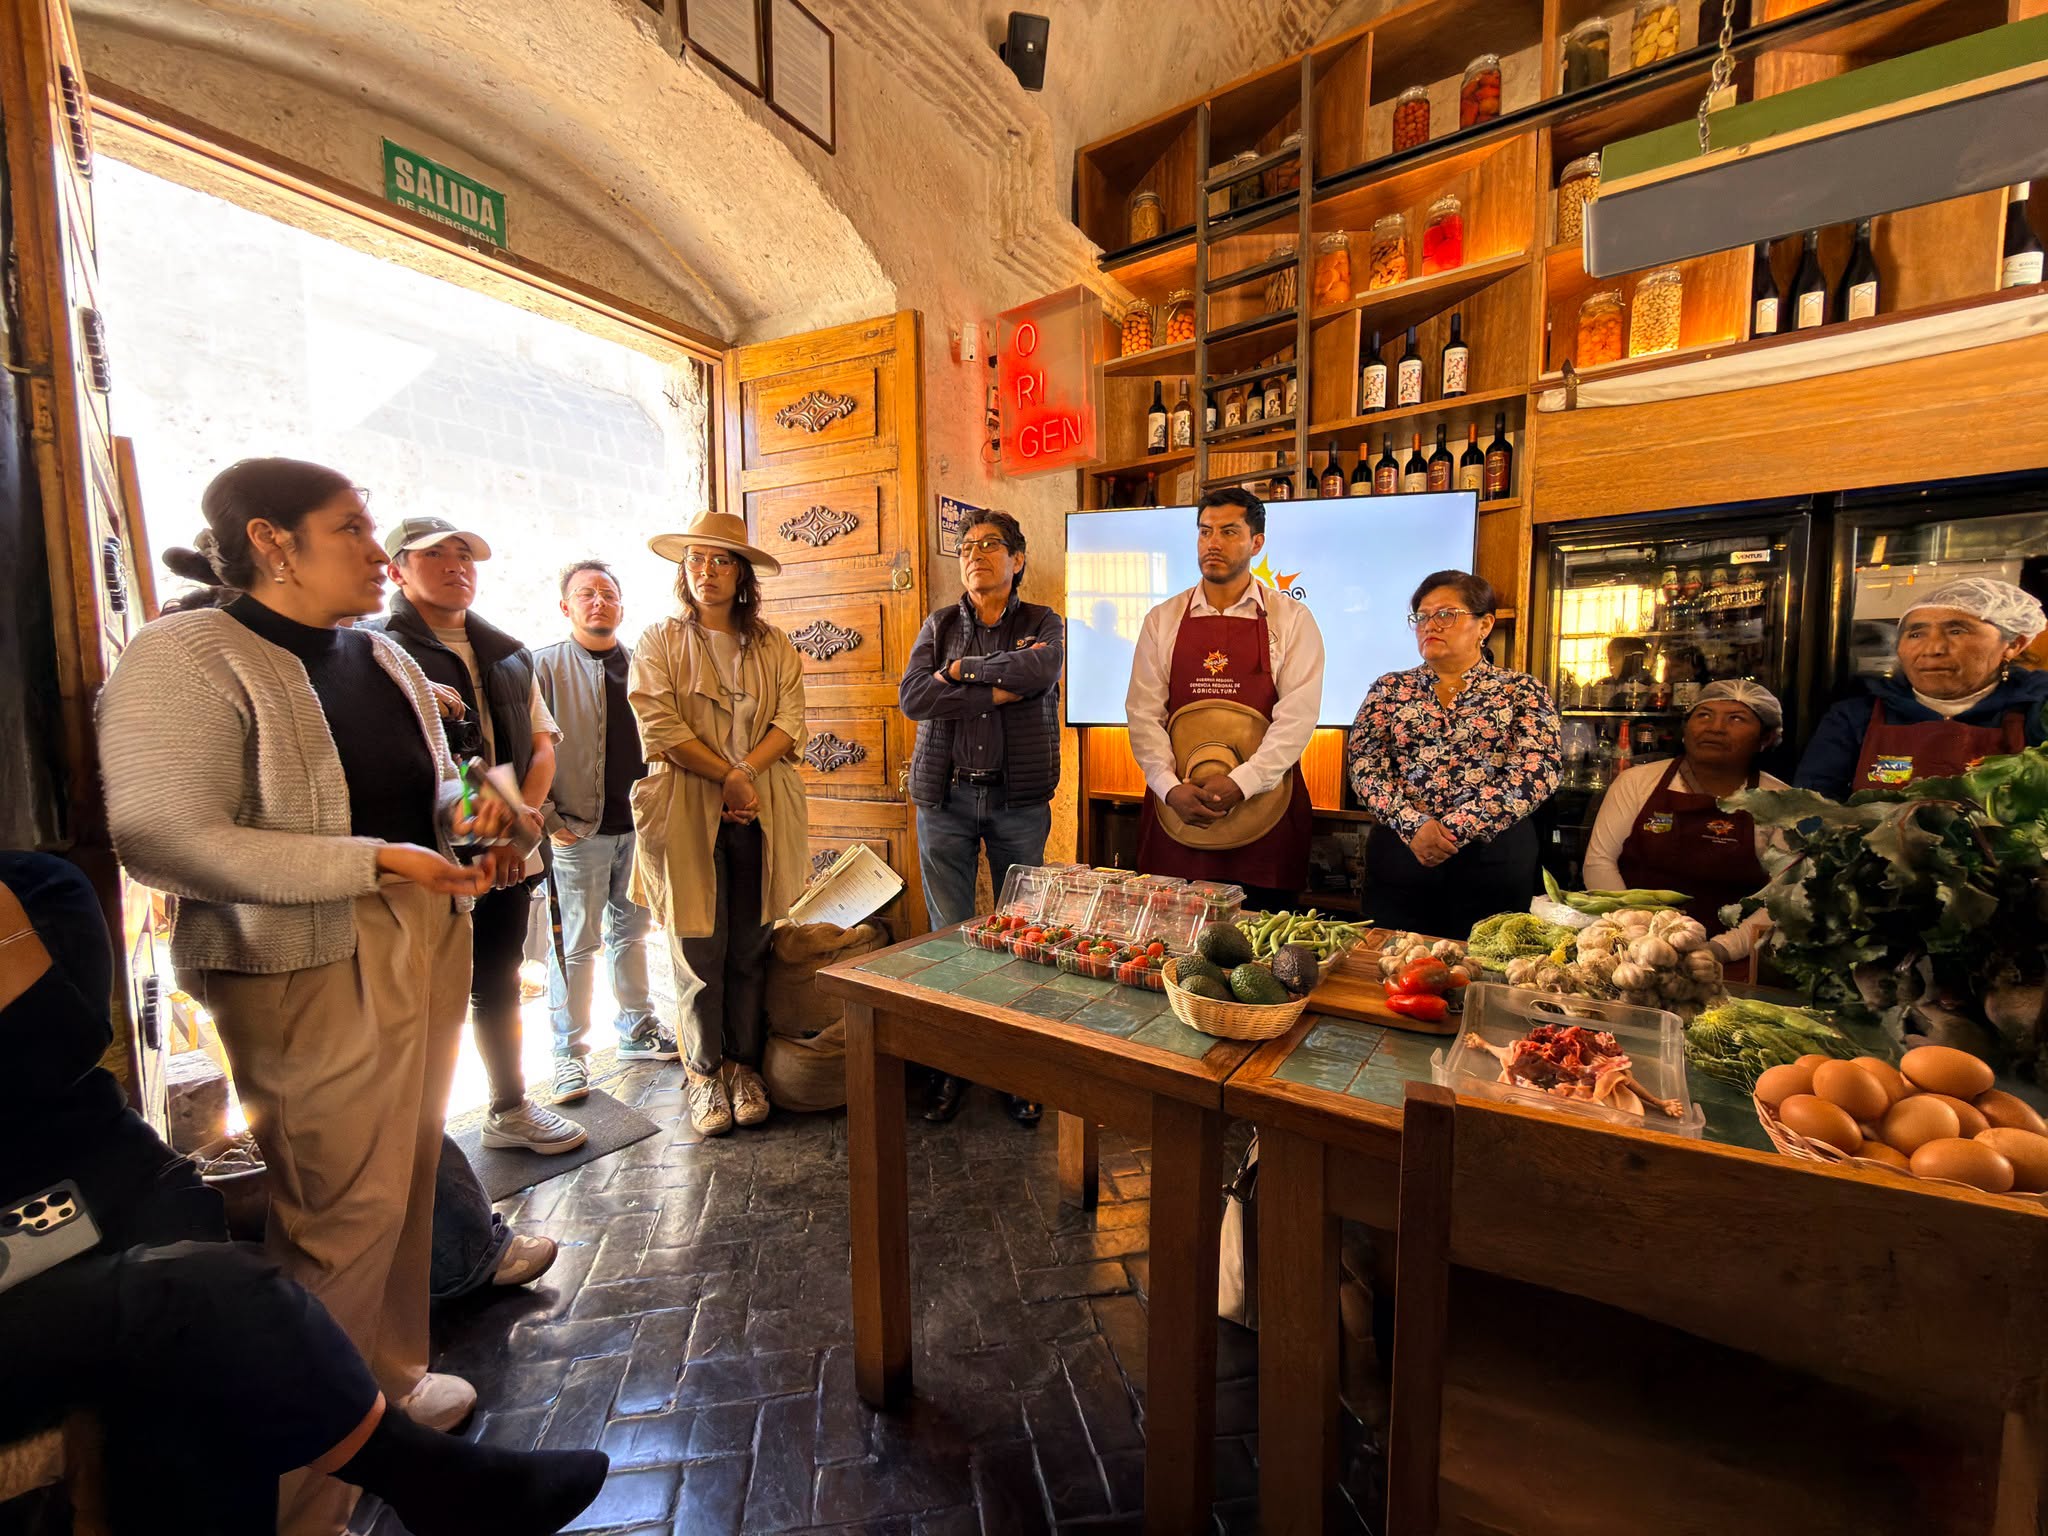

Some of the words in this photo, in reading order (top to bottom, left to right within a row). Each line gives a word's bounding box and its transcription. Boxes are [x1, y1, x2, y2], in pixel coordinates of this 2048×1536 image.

[394, 156, 497, 231] SALIDA
[397, 196, 416, 212] DE
[418, 205, 498, 246] EMERGENCIA
[1016, 322, 1037, 357] O
[1016, 370, 1045, 410] RI
[1019, 414, 1083, 458] GEN
